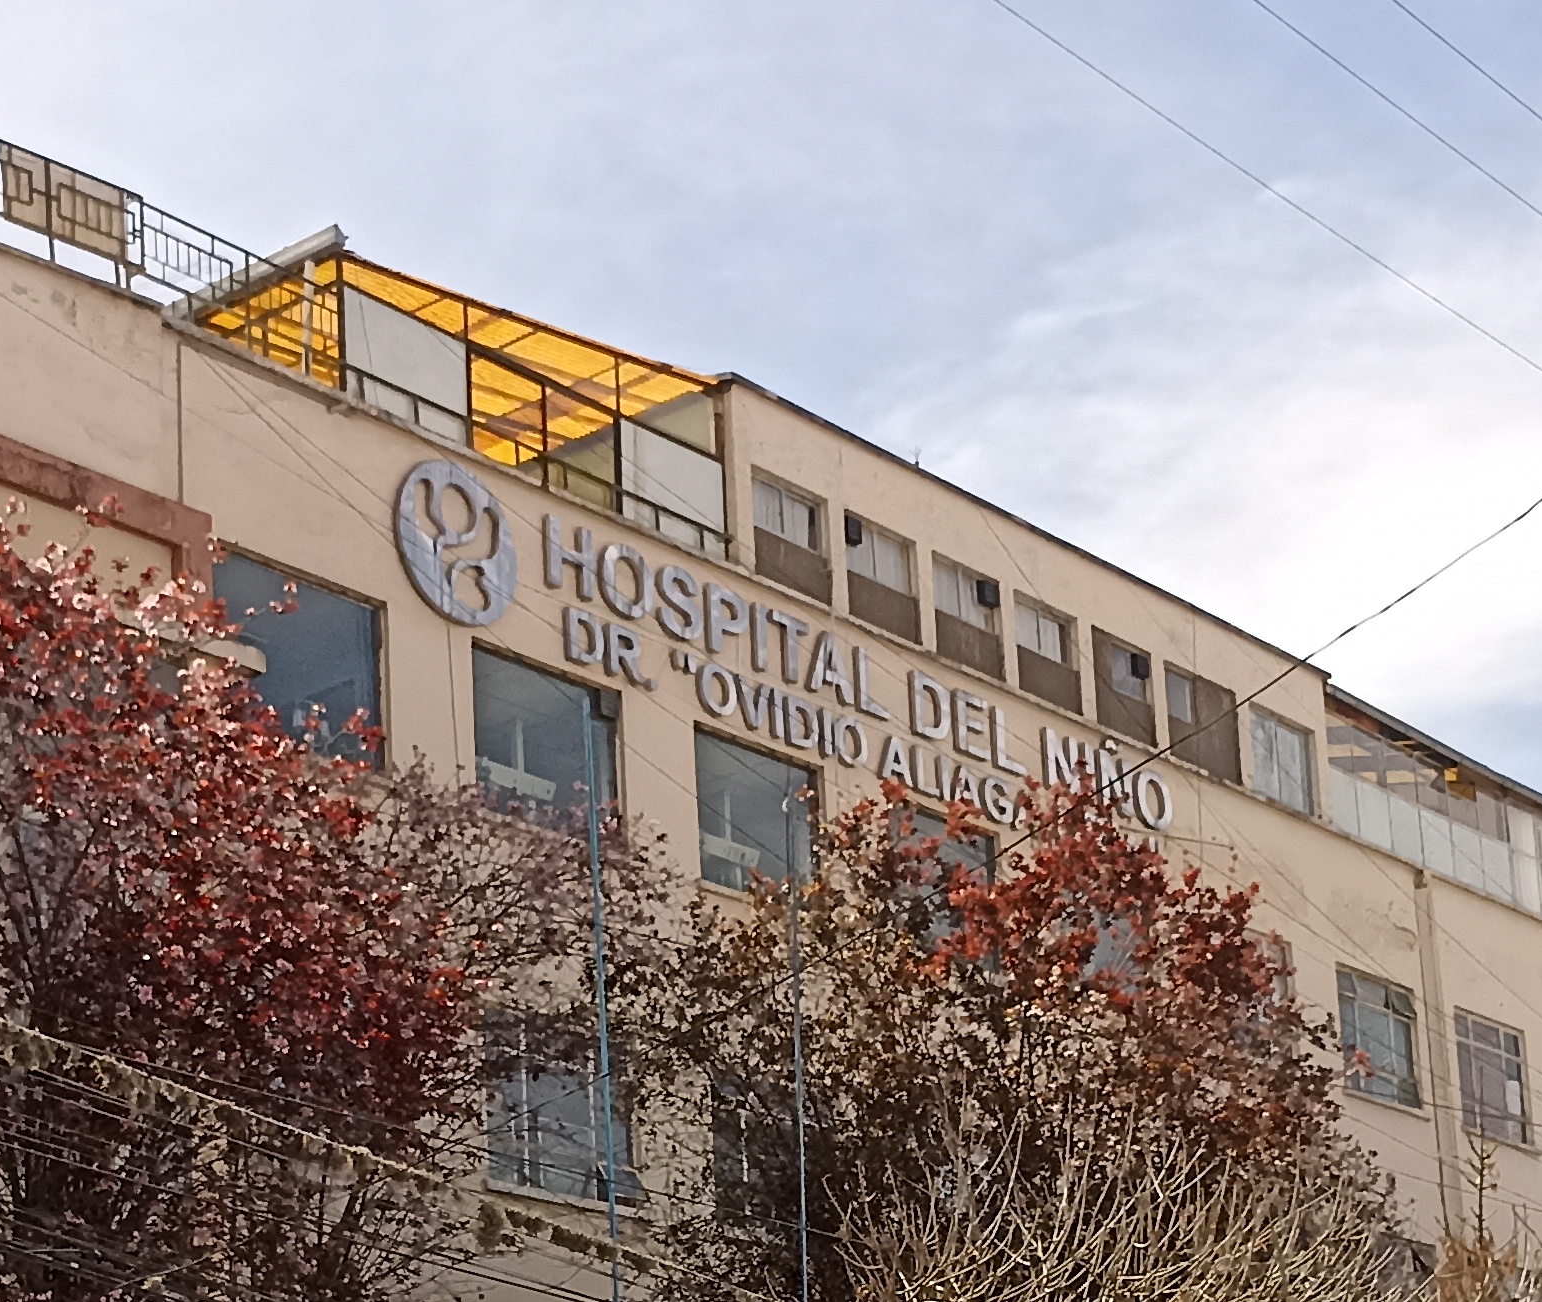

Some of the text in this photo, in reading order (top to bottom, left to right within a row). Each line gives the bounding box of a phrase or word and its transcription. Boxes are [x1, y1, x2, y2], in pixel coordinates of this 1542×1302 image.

[543, 513, 1172, 831] HOSPITAL DEL NIÑO
[562, 606, 658, 691] DR.
